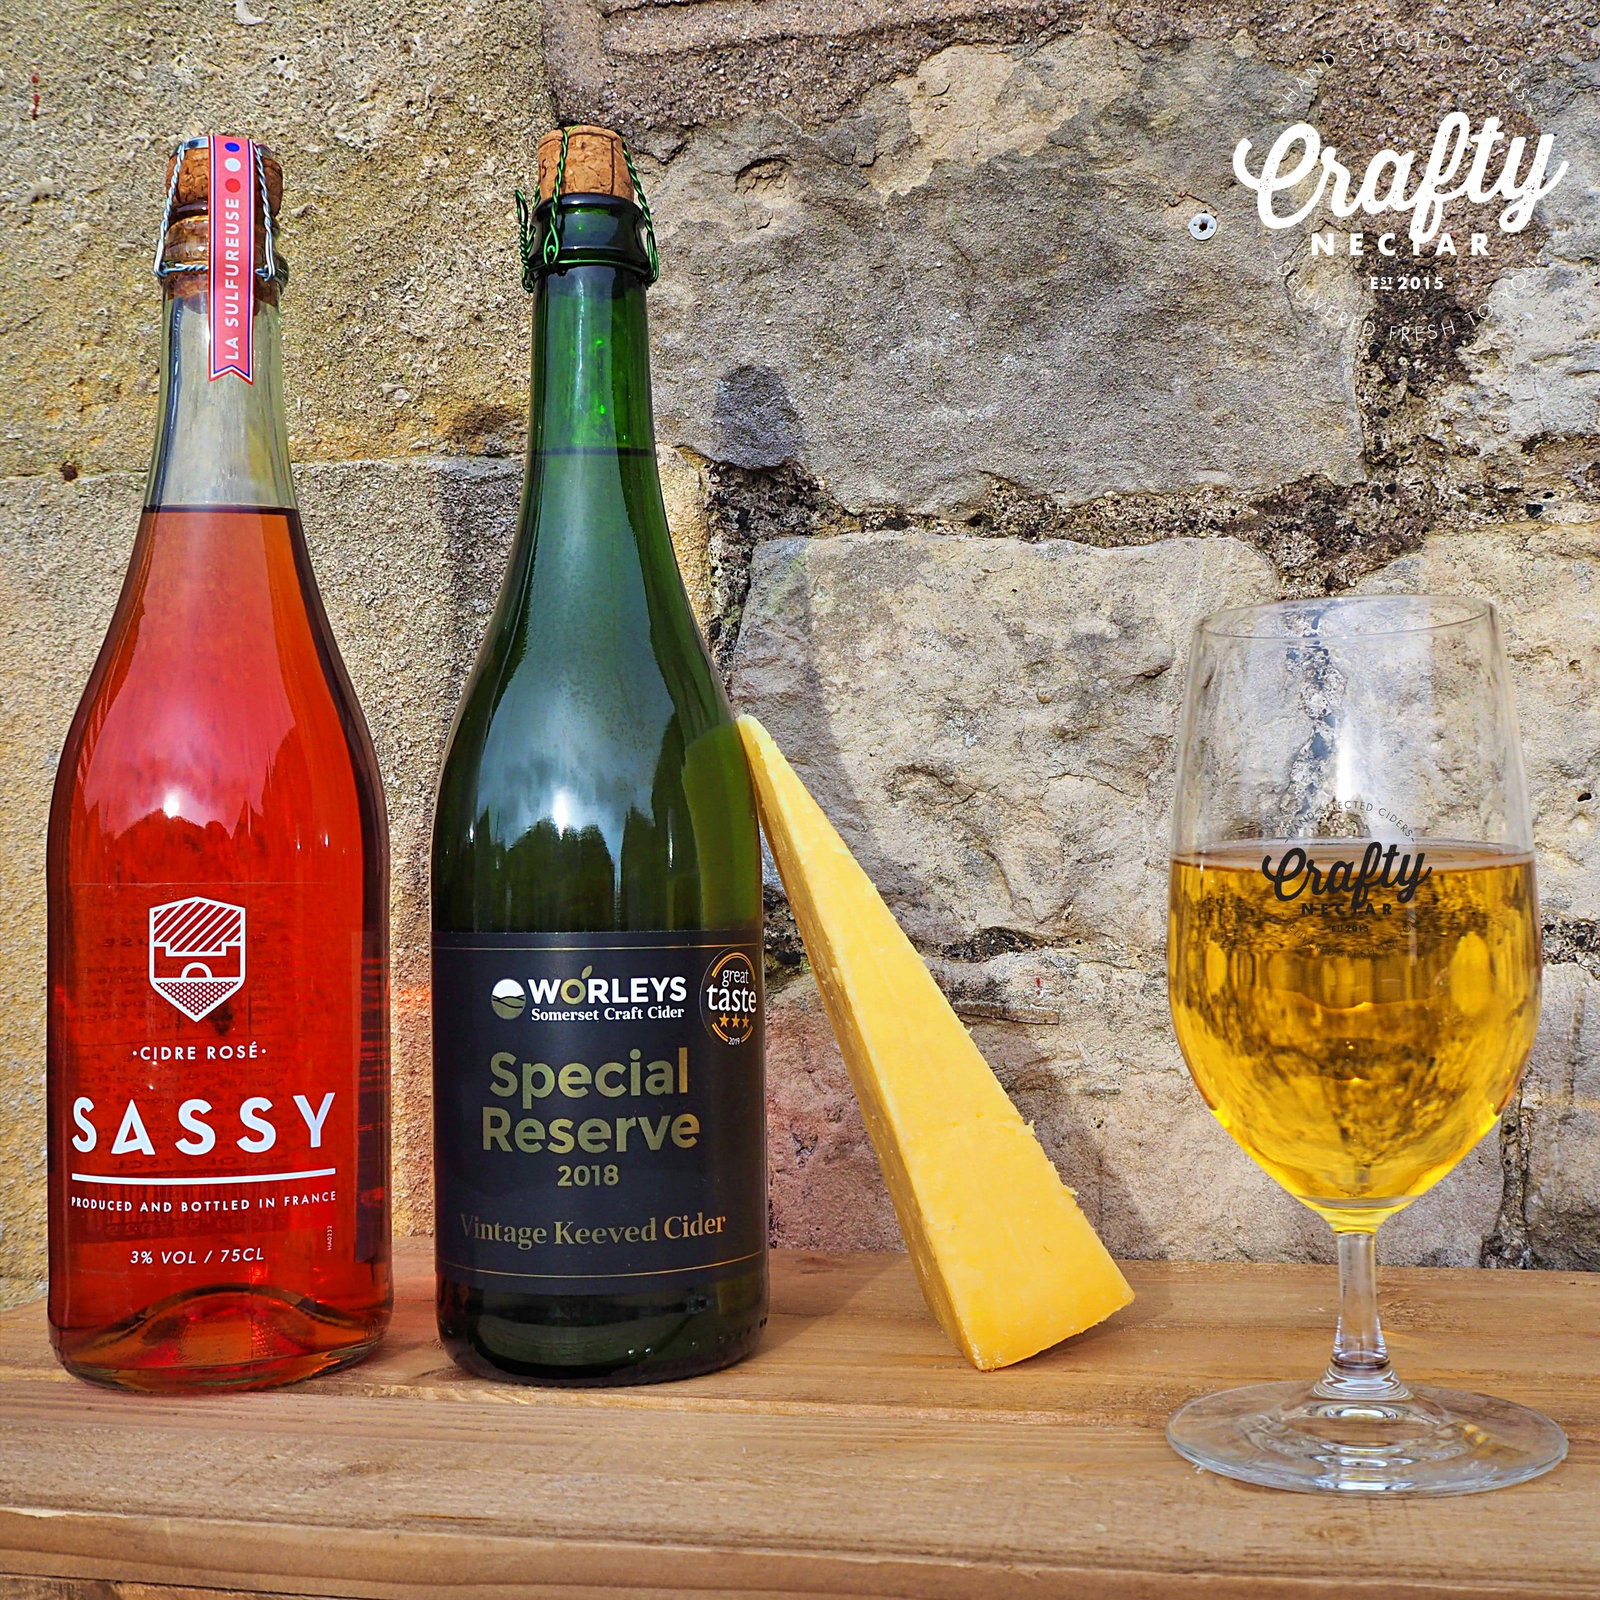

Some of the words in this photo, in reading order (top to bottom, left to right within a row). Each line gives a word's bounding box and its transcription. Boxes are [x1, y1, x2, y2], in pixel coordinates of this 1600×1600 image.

[224, 198, 240, 327] SULFUREUSE
[224, 336, 239, 360] LA
[1262, 842, 1432, 908] Crafty
[528, 976, 688, 1006] WORLEYS
[722, 969, 749, 987] great
[706, 984, 757, 1013] taste
[531, 1008, 599, 1022] Somerset
[604, 1007, 644, 1021] Craft
[648, 1006, 685, 1020] Cider
[728, 1036, 741, 1046] 2019
[489, 1047, 689, 1110] Special
[71, 1092, 336, 1156] SASSY
[482, 1106, 701, 1154] Reserve
[557, 1164, 620, 1187] 2018
[71, 1196, 132, 1212] PRODUCED
[140, 1202, 172, 1213] AND
[181, 1199, 250, 1213] BOTTLED
[259, 1197, 275, 1209] IN
[284, 1190, 336, 1207] FRANCE
[460, 1213, 547, 1249] Vintage
[553, 1218, 657, 1244] Keeved
[664, 1212, 726, 1239] Cider
[130, 1251, 153, 1264] 3%
[161, 1250, 196, 1265] VOL
[204, 1250, 212, 1264] /
[220, 1248, 264, 1263] 75CL
